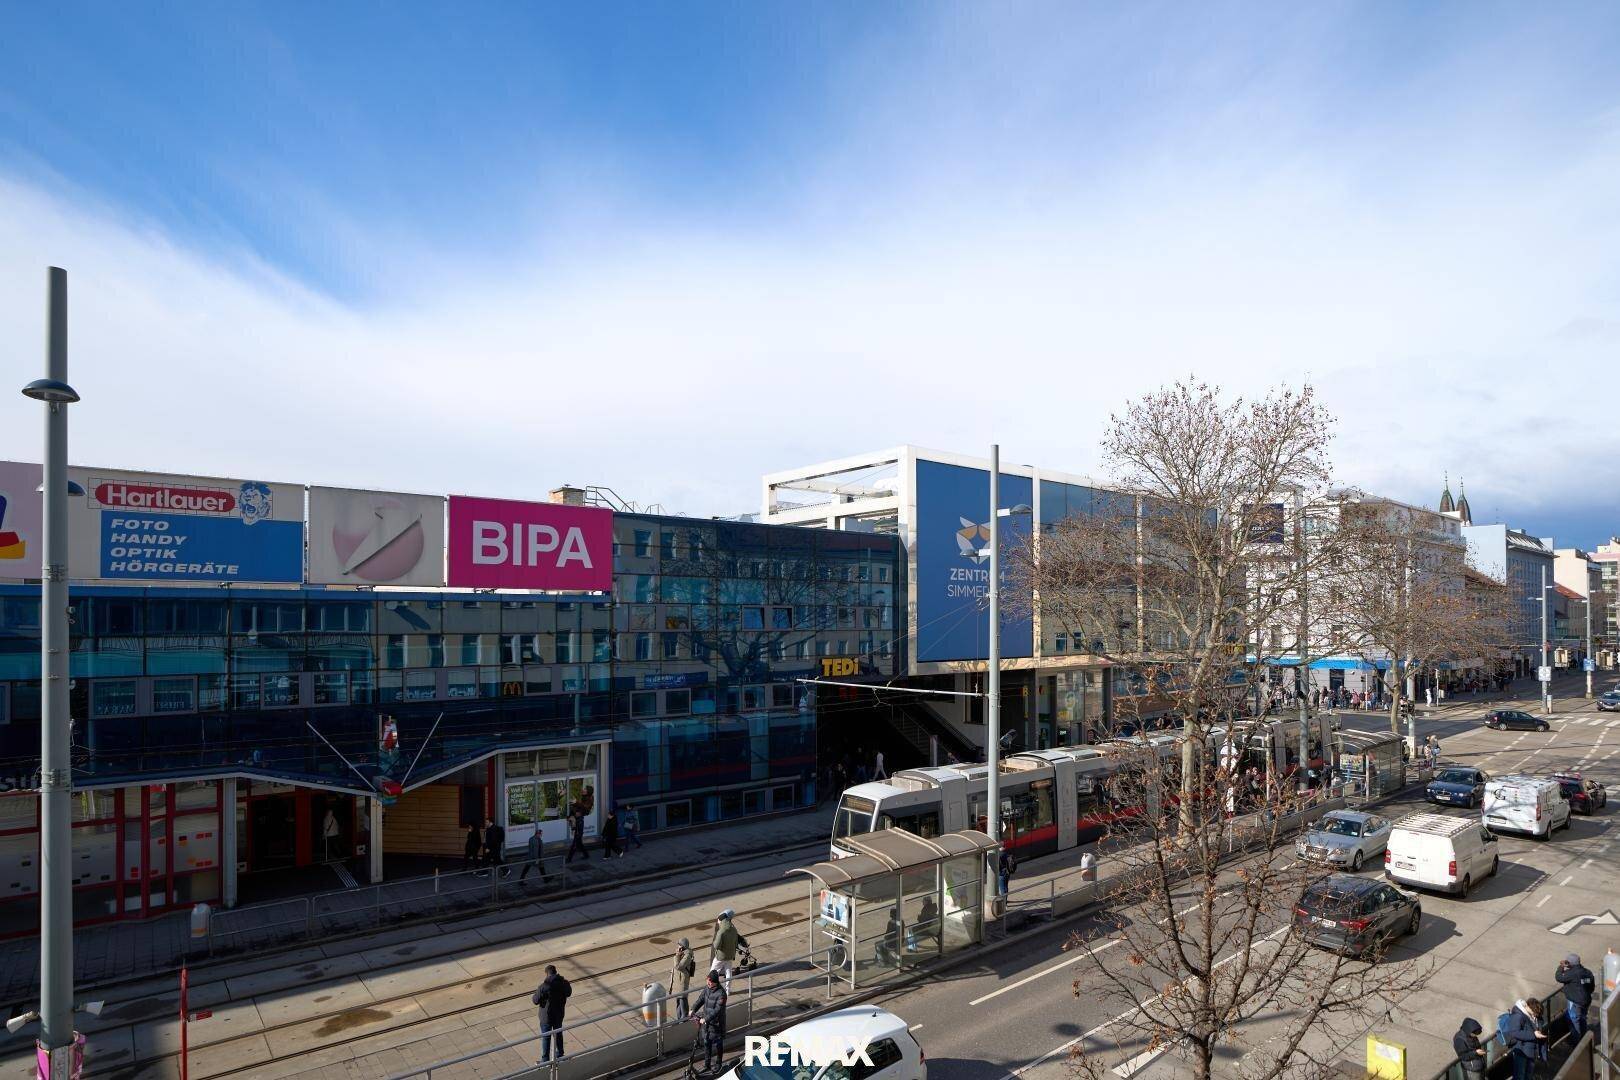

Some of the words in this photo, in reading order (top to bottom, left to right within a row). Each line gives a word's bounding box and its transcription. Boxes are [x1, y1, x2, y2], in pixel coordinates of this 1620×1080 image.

[107, 485, 227, 511] Hartlauer
[110, 518, 170, 531] FOTO
[110, 533, 188, 545] HANDY
[472, 520, 593, 569] BIPA
[110, 547, 178, 559] OPTIK
[110, 560, 240, 575] HÖRGERÄTE
[950, 568, 1005, 583] ZENTRM
[821, 658, 860, 677] TEDi
